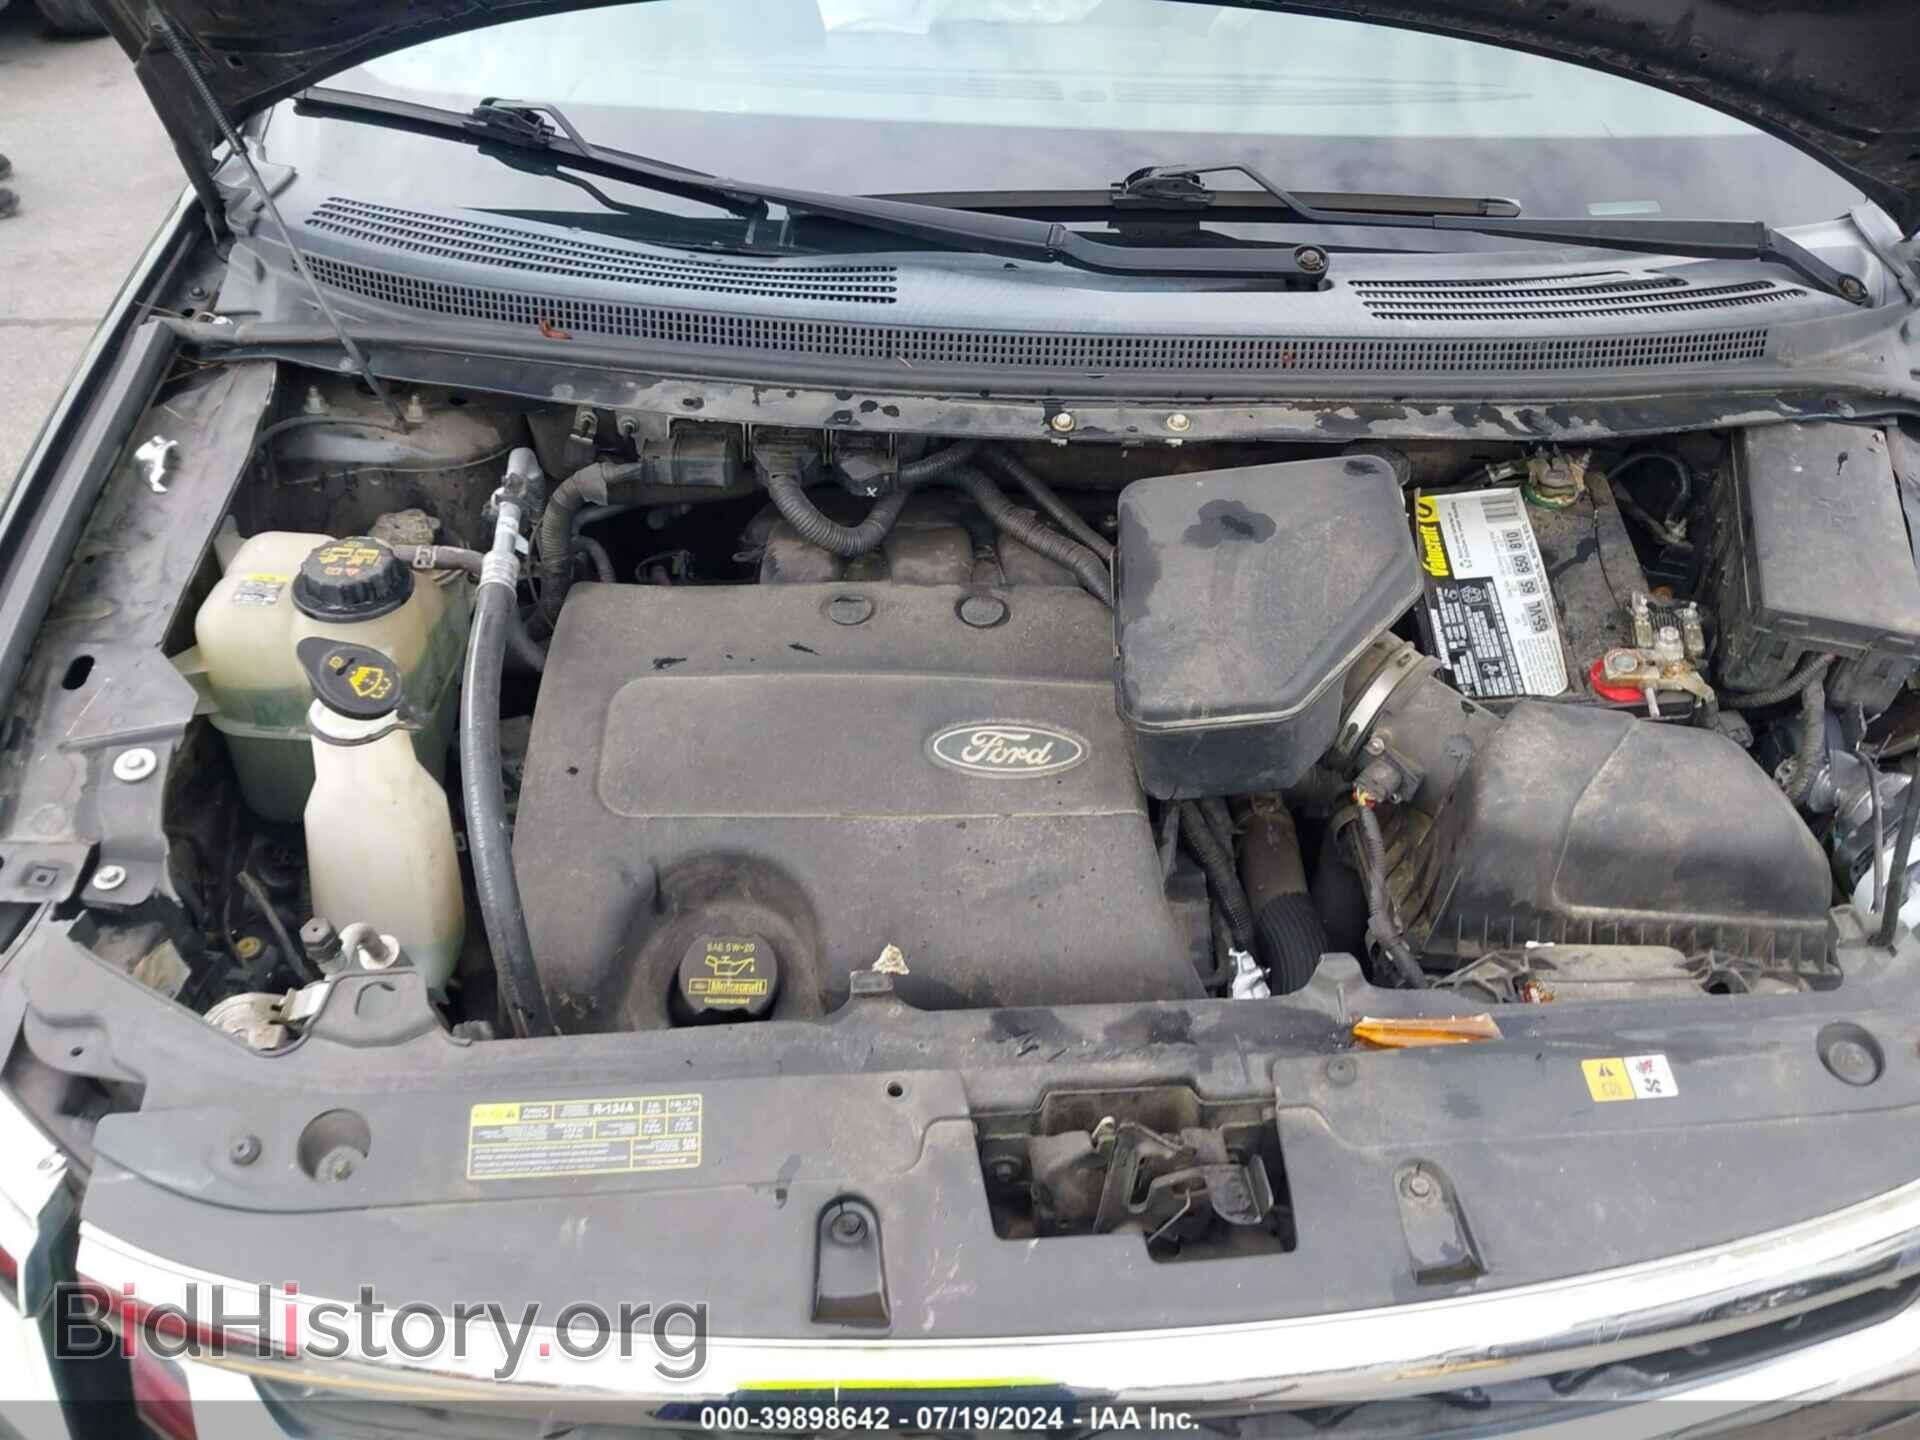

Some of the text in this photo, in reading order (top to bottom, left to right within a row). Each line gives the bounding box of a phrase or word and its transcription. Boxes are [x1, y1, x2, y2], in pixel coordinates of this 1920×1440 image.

[1505, 531, 1521, 549] 810
[1513, 555, 1530, 573] 650
[1520, 580, 1536, 594] 65
[1528, 600, 1548, 633] 65-VL
[961, 732, 1054, 765] Ford
[726, 943, 755, 952] 5W-20
